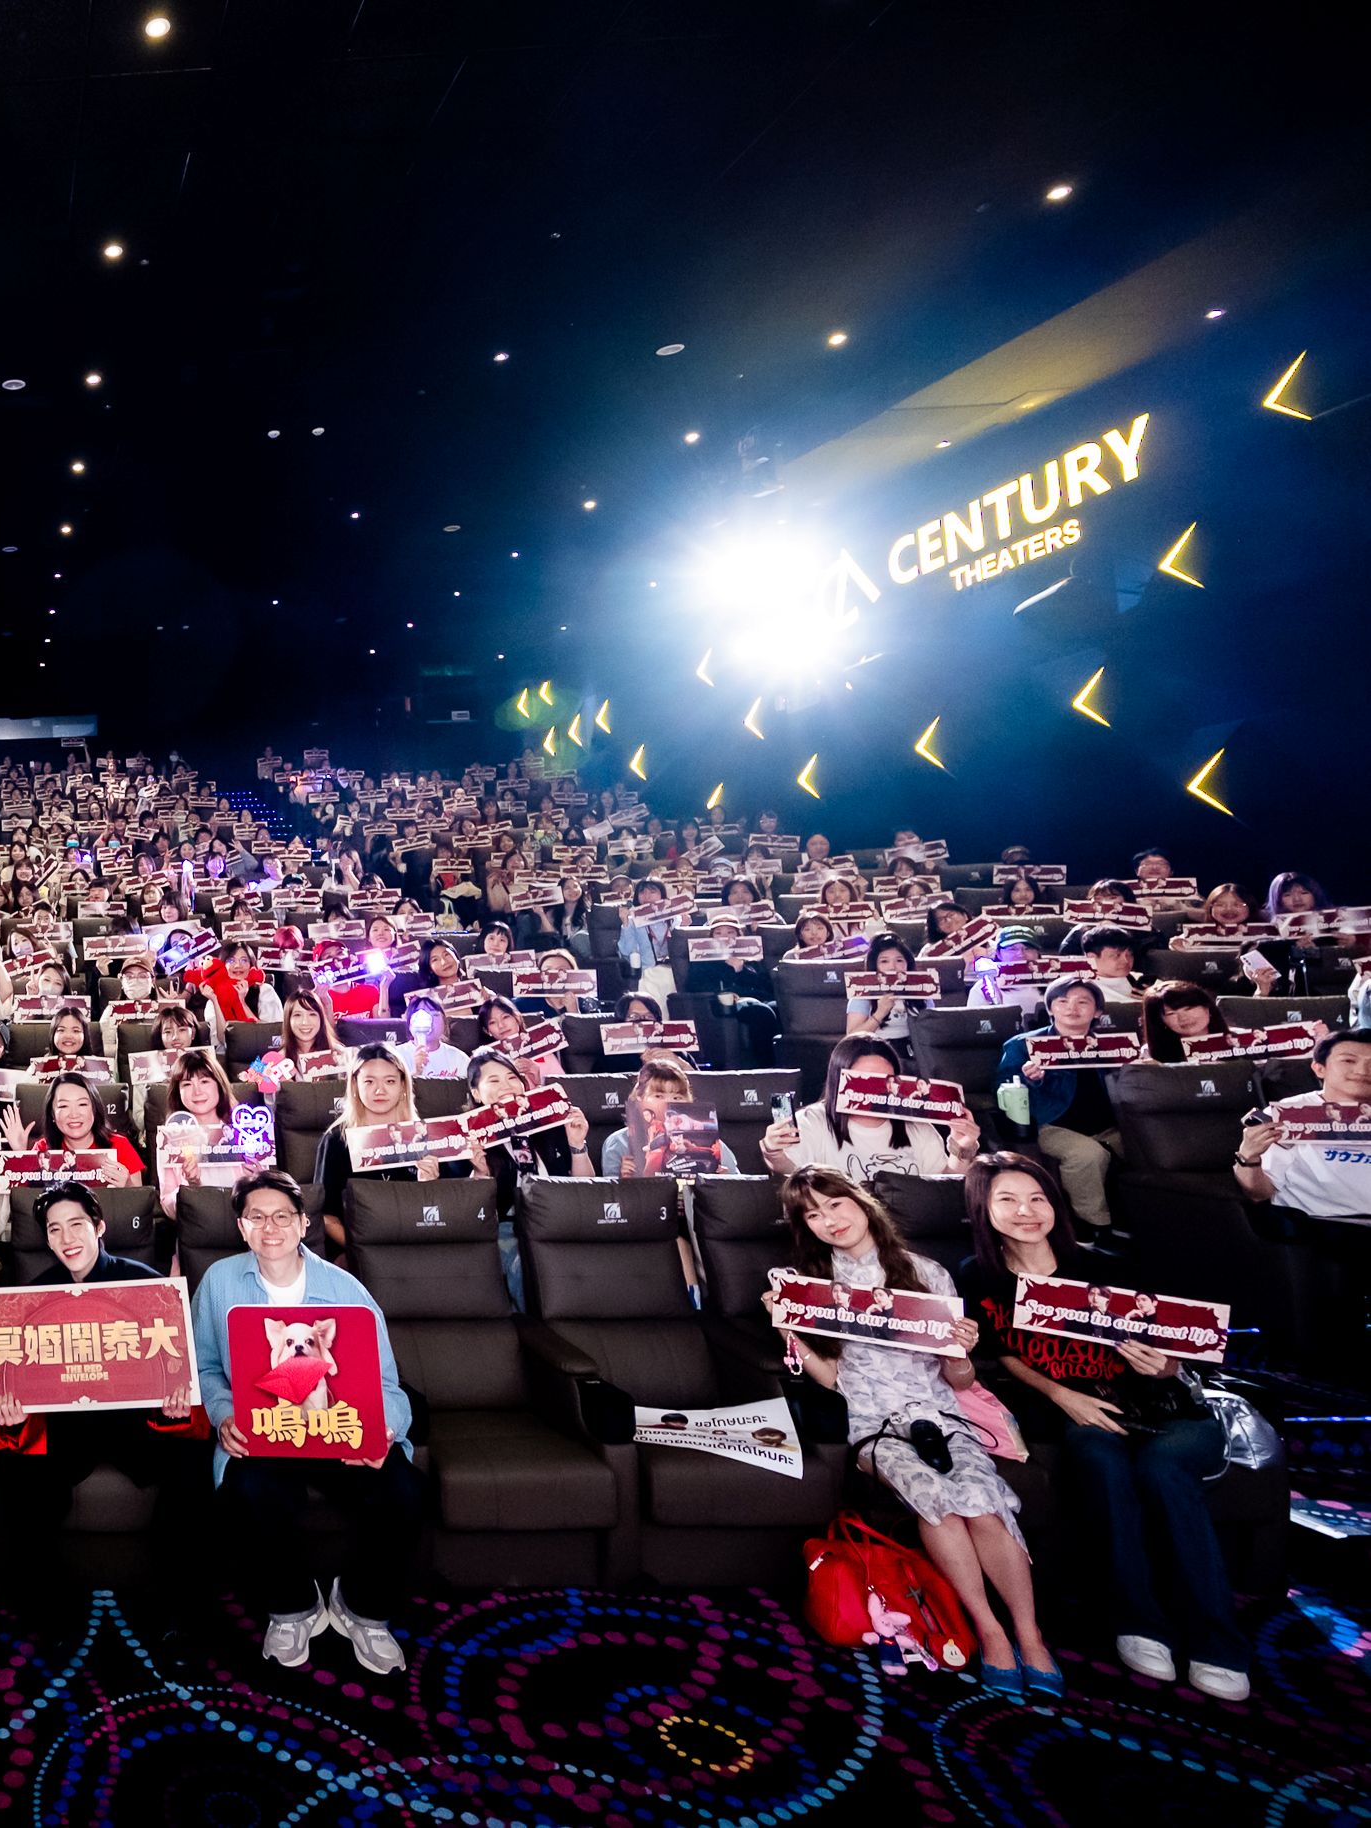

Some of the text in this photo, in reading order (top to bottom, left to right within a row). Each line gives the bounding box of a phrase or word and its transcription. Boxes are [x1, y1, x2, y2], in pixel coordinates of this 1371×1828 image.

[888, 413, 1150, 585] CENTURY
[949, 518, 1081, 591] THEATERS
[1336, 1014, 1343, 1024] 4
[1192, 1040, 1314, 1061] See you in our next life
[106, 1104, 117, 1115] 12
[845, 1092, 950, 1112] See you in our next
[468, 1105, 570, 1141] See you in our next life
[1307, 1123, 1331, 1134] you
[1332, 1121, 1348, 1131] in
[374, 1138, 466, 1158] you in our next life
[5, 1173, 21, 1181] See
[22, 1174, 40, 1182] you
[477, 1207, 486, 1221] 4
[659, 1206, 667, 1221] 3
[132, 1216, 140, 1229] 6
[781, 1298, 805, 1315] See
[806, 1304, 836, 1320] you
[837, 1307, 855, 1324] in
[856, 1312, 887, 1328] our
[888, 1317, 925, 1333] next
[1026, 1300, 1054, 1317] See
[1056, 1307, 1089, 1324] you
[1090, 1310, 1111, 1328] in
[1112, 1317, 1147, 1333] our
[1148, 1322, 1188, 1339] next
[1190, 1326, 1218, 1346] life
[65, 1364, 103, 1373] THE RED
[60, 1371, 110, 1383] ENVELOPE
